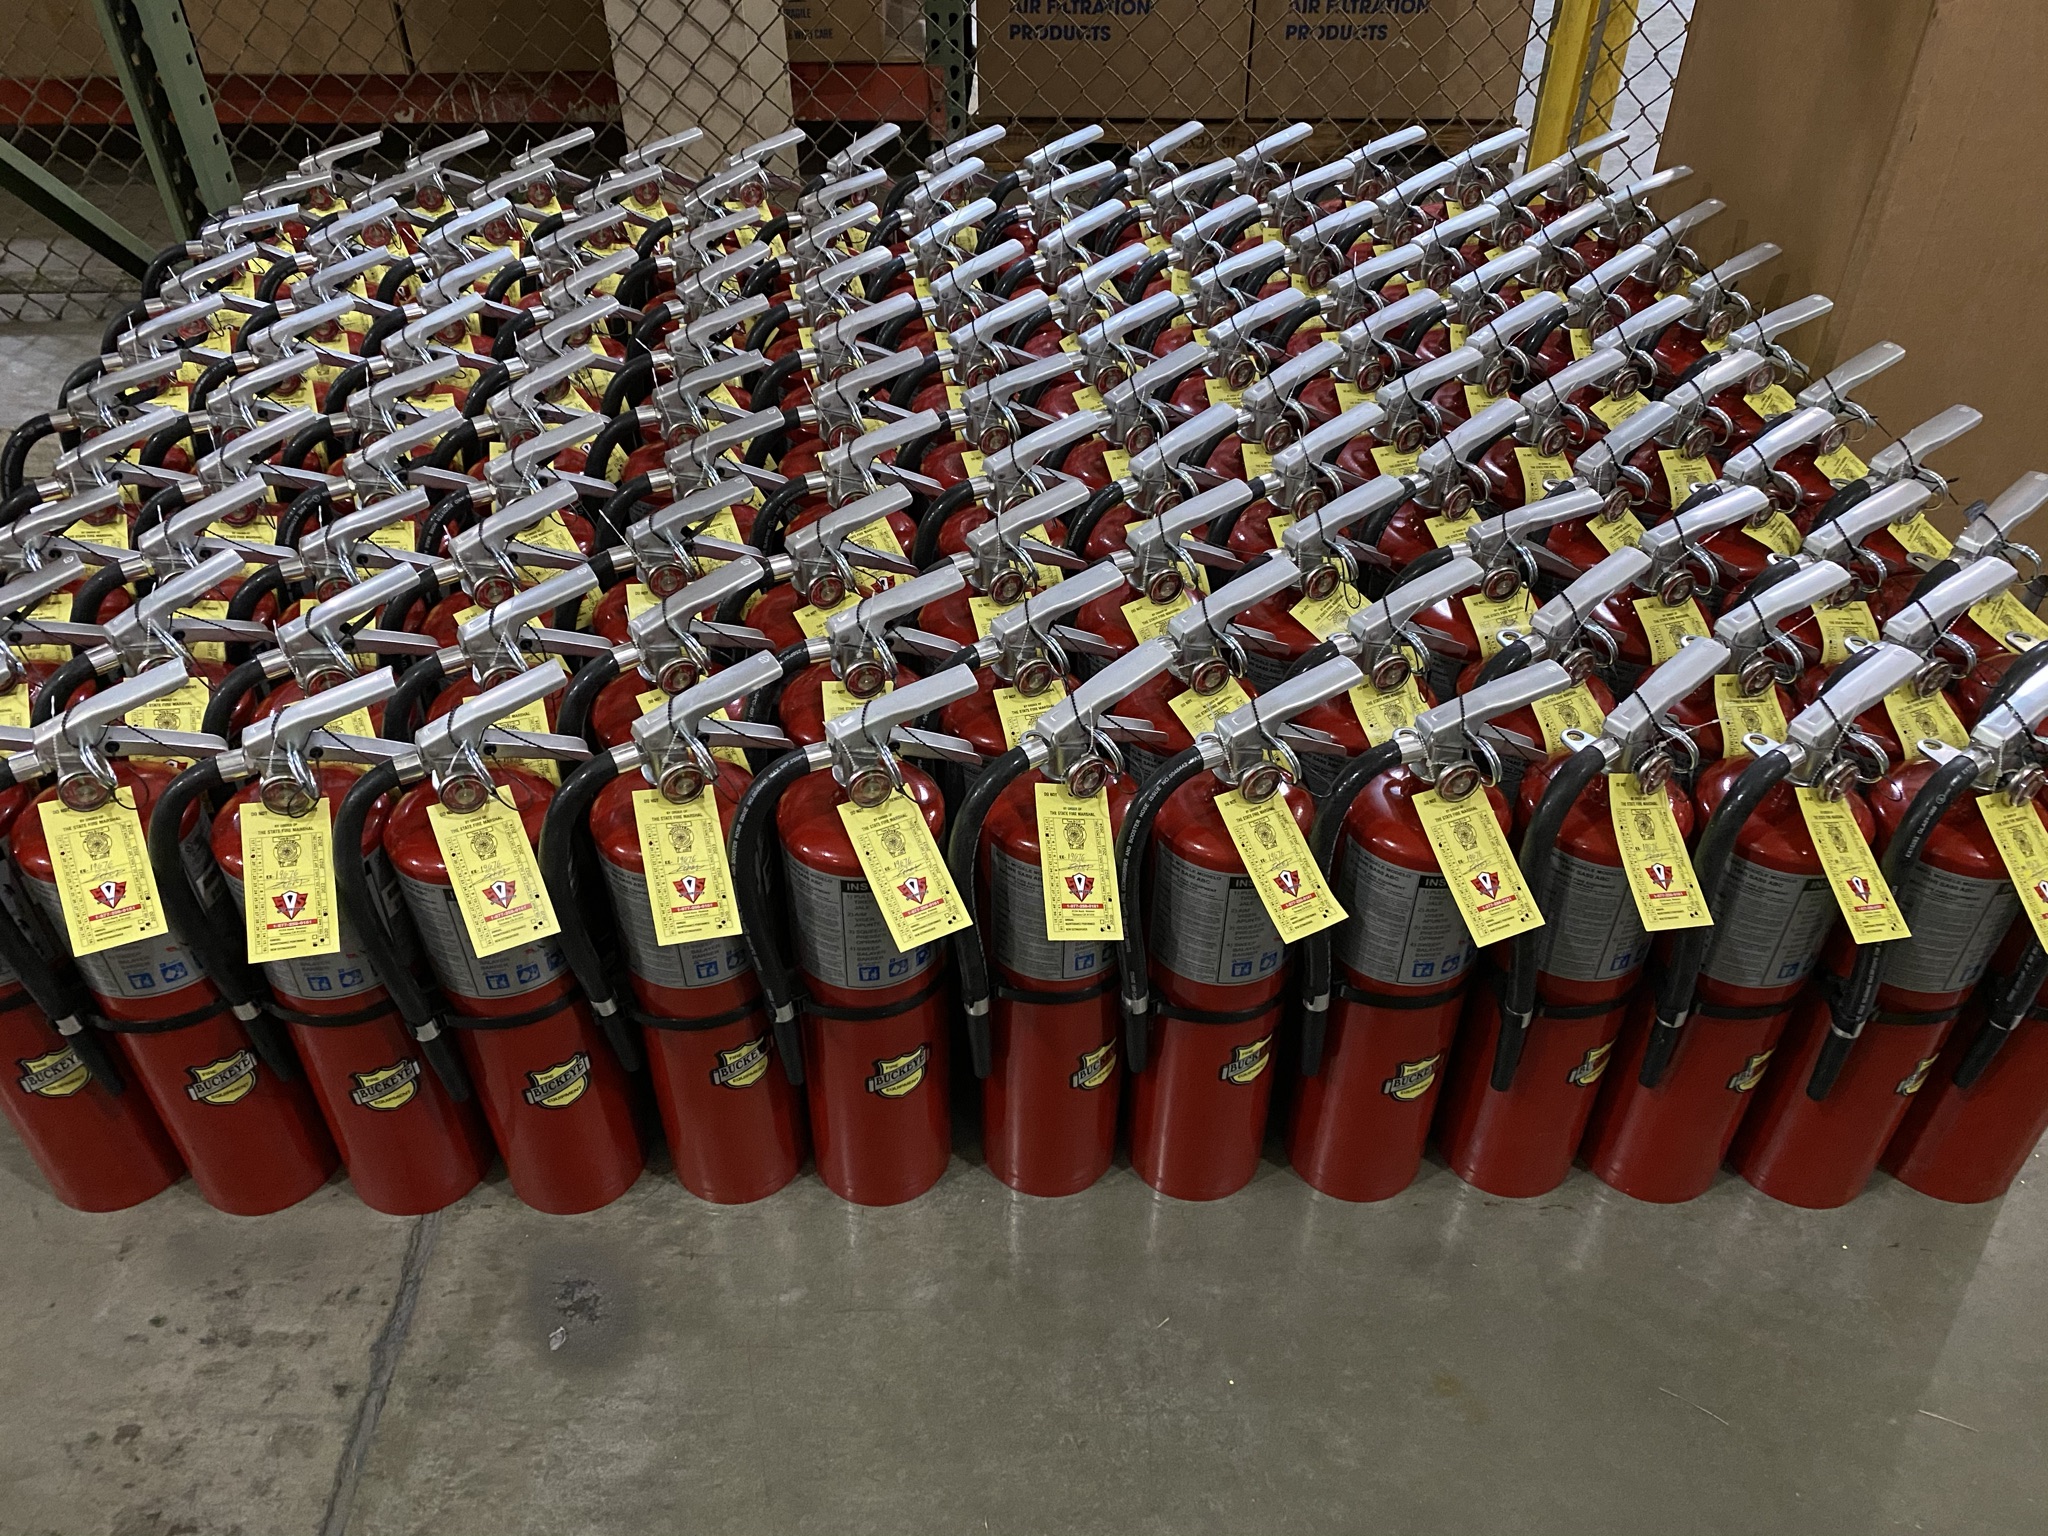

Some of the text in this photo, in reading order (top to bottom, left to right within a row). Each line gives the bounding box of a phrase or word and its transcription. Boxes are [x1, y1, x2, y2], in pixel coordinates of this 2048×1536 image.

[1009, 24, 1111, 41] PRODUCTS
[1285, 24, 1388, 41] PRODUCTS
[1128, 819, 1141, 845] BOOSTER
[1138, 803, 1150, 818] HOSE
[1148, 785, 1162, 802] ISSUE
[27, 1054, 78, 1086] BUCKEY
[195, 1057, 251, 1094] BUCKEYE
[360, 1066, 413, 1099] BUCKEYE
[533, 1061, 584, 1097] BUCKEYE
[876, 1053, 925, 1086] BUCKEYE
